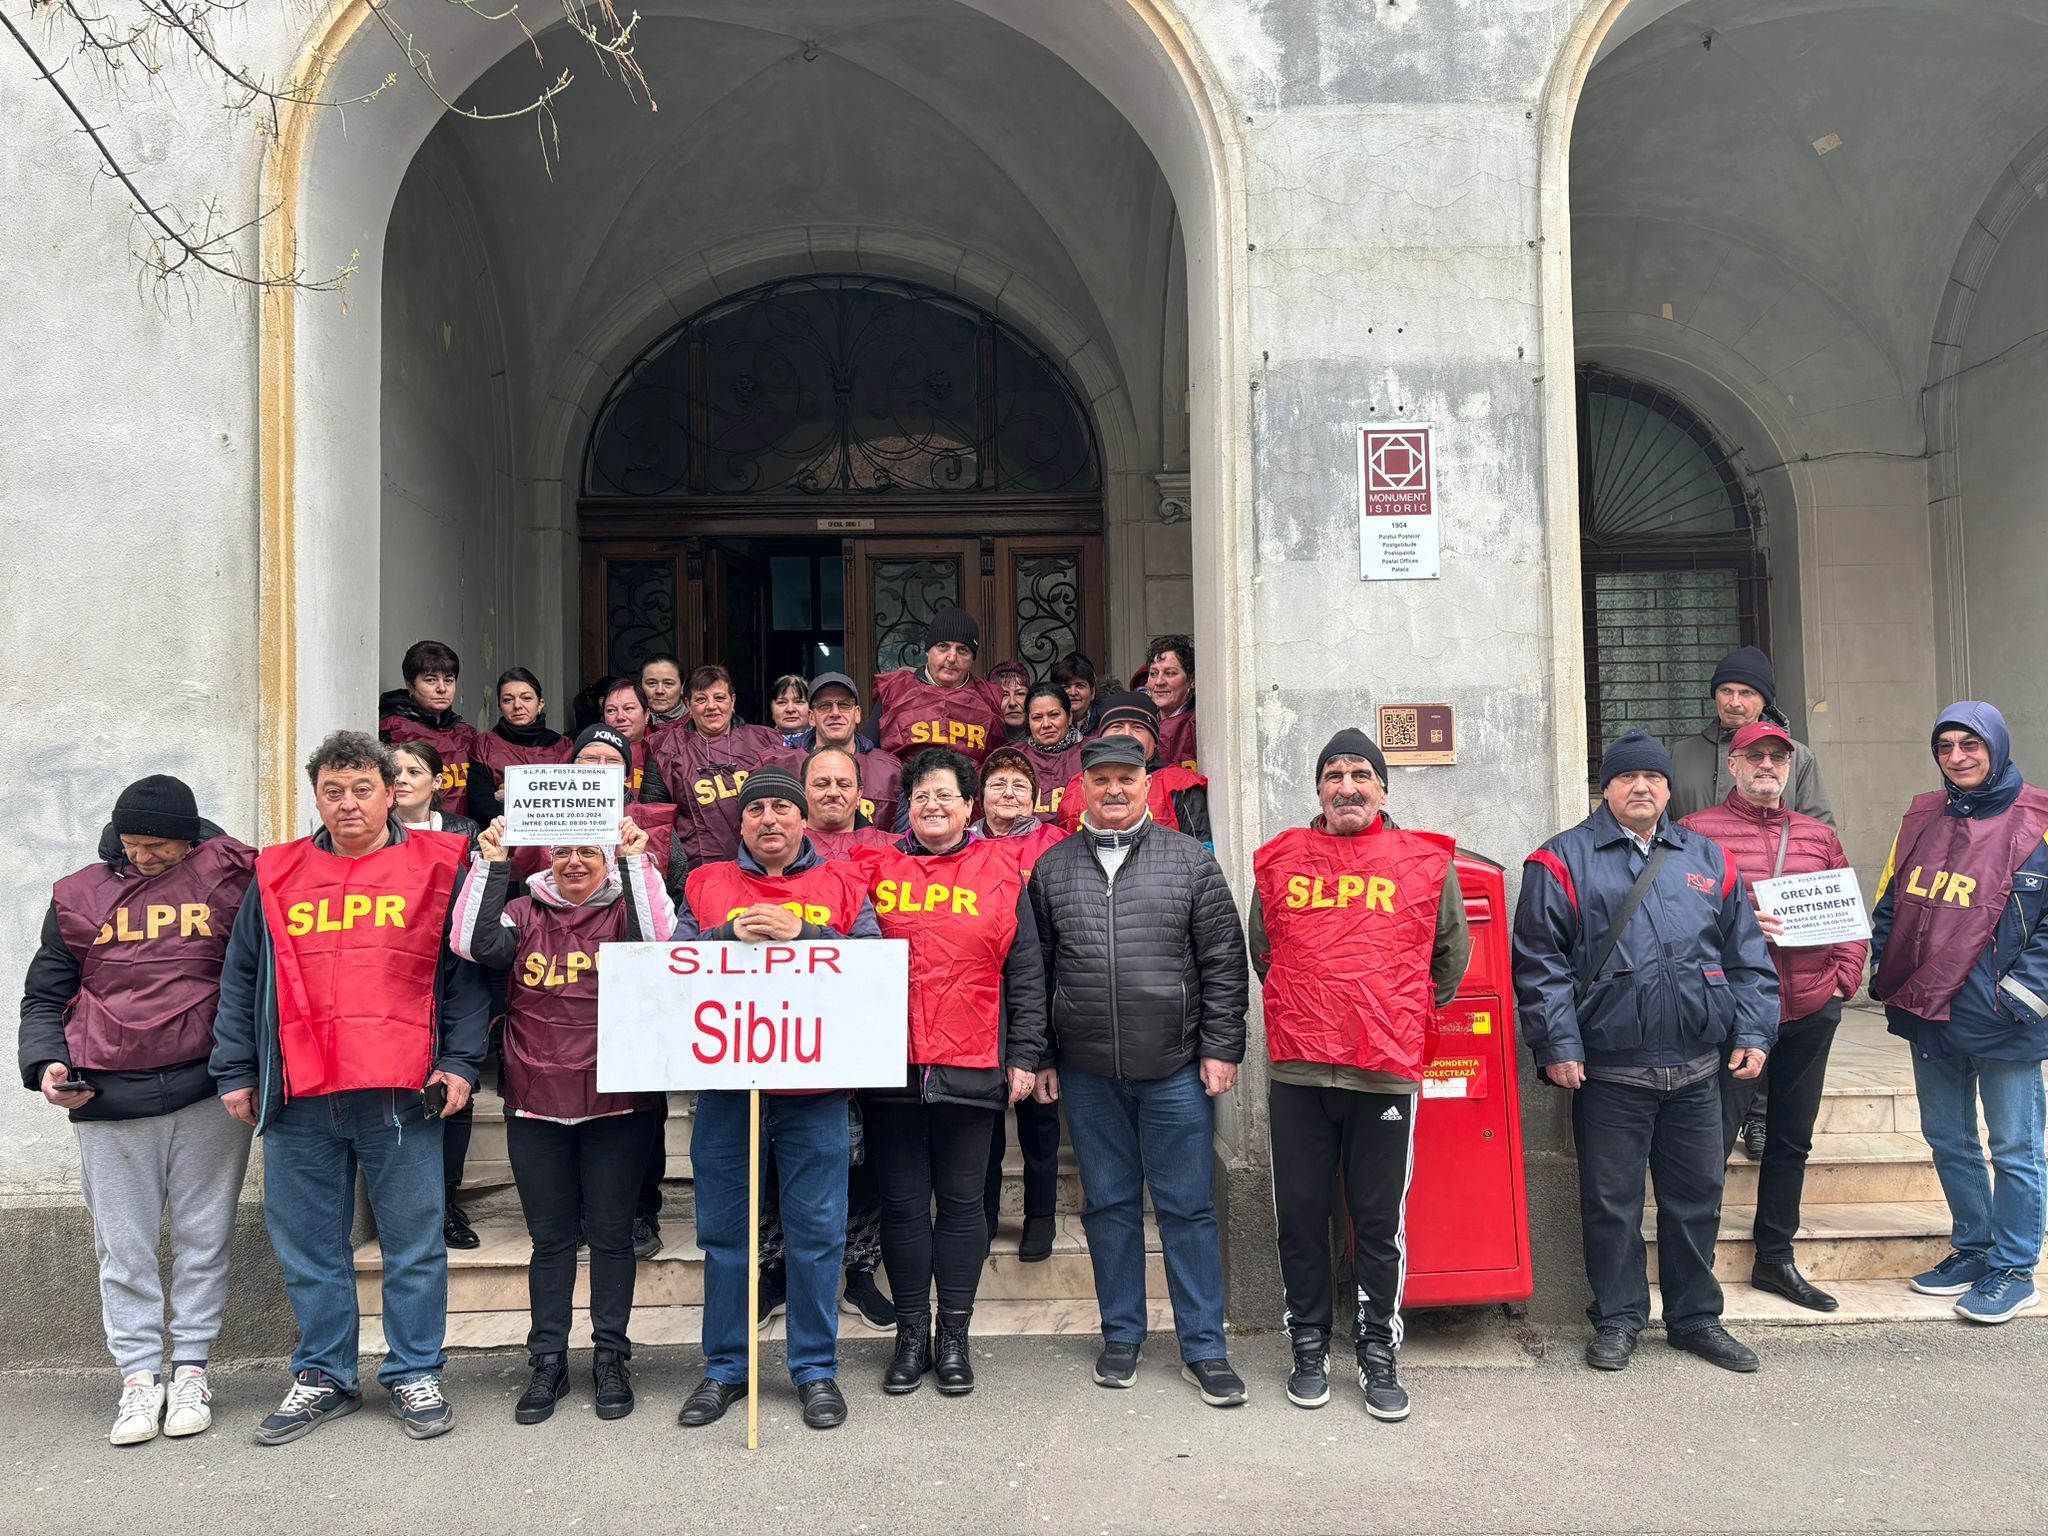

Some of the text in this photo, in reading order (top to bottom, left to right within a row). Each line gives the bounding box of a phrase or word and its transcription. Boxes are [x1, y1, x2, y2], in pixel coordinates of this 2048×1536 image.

[1369, 492, 1426, 503] MONUMENT
[1369, 503, 1428, 513] ISTORIC
[594, 730, 623, 748] KING
[911, 720, 986, 750] SLPR
[528, 779, 601, 791] GREVĂ DE
[513, 798, 616, 808] AVERTISMENT
[875, 879, 980, 917] SLPR
[1285, 875, 1396, 914] SLPR
[1781, 884, 1841, 900] GREVĂ DE
[287, 894, 406, 937] SLPR
[1772, 897, 1856, 916] AVERTISMENT
[668, 947, 842, 975] S.L.P.R
[691, 1000, 822, 1065] Sibiu
[1423, 1068, 1476, 1077] COLECTEAZĂ
